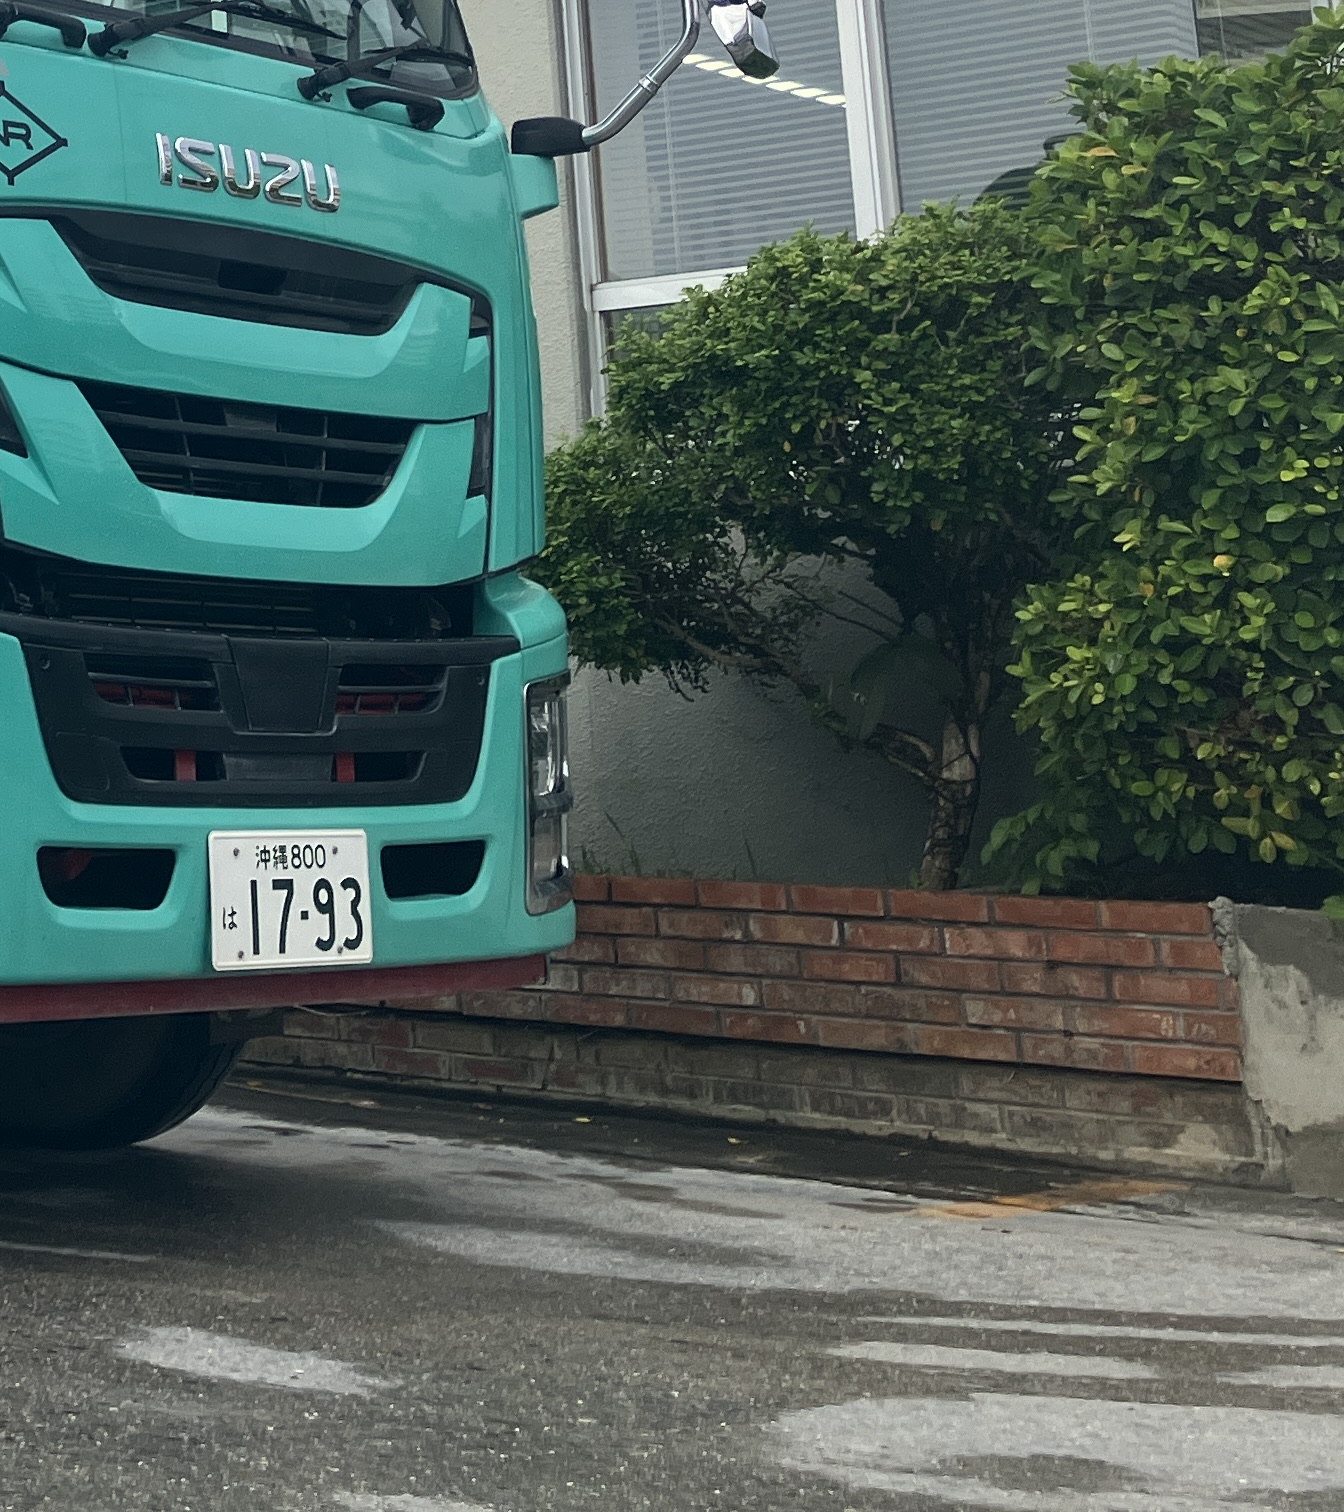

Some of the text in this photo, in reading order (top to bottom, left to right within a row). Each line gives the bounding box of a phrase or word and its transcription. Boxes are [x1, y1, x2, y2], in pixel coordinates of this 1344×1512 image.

[155, 132, 341, 213] ISUZU
[222, 876, 364, 956] は 17-93
